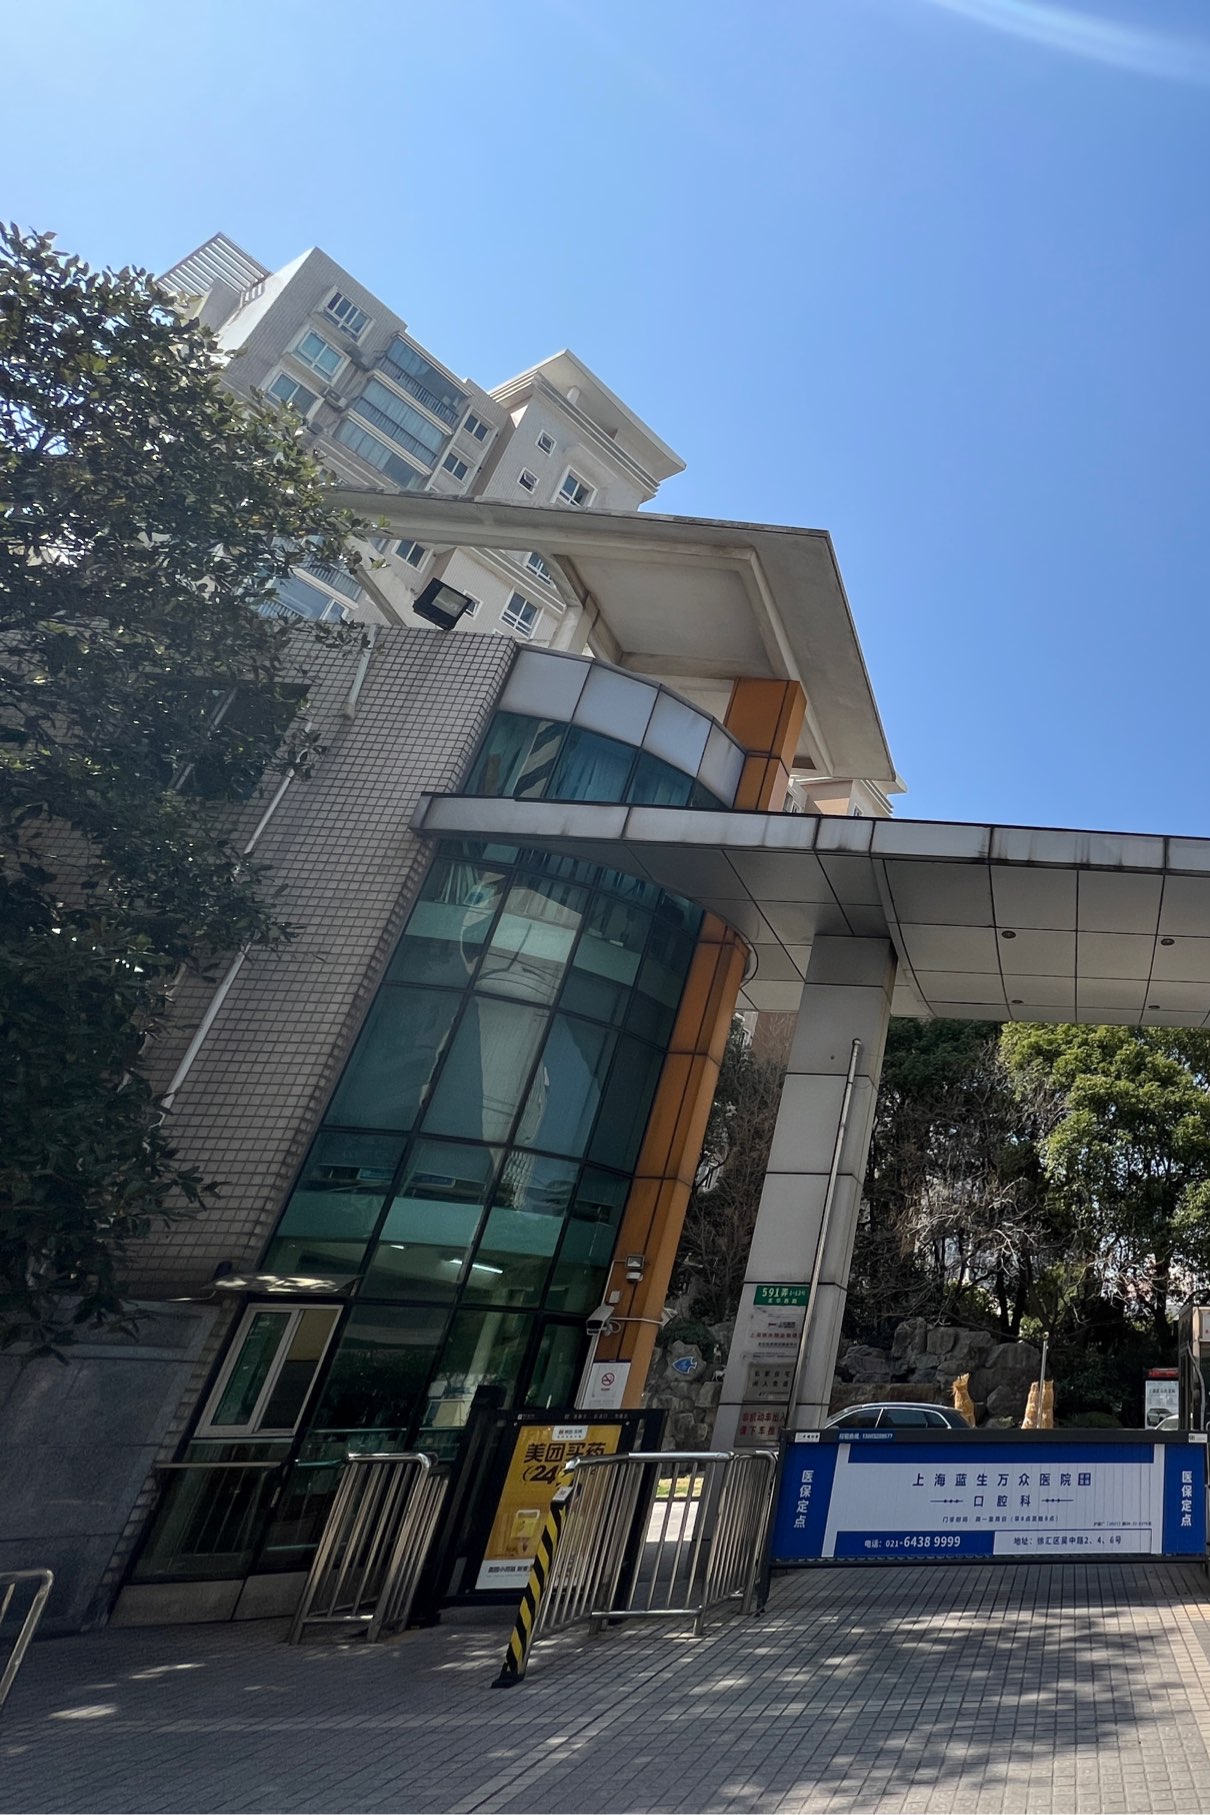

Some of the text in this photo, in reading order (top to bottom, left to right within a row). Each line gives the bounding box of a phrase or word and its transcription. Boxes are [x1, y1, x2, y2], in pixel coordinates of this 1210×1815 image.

[912, 1472, 1072, 1487] 上海蓝生万众医院
[793, 1469, 815, 1528] 医保定点
[973, 1494, 1031, 1508] 口腔科
[1180, 1470, 1193, 1527] 医保定点
